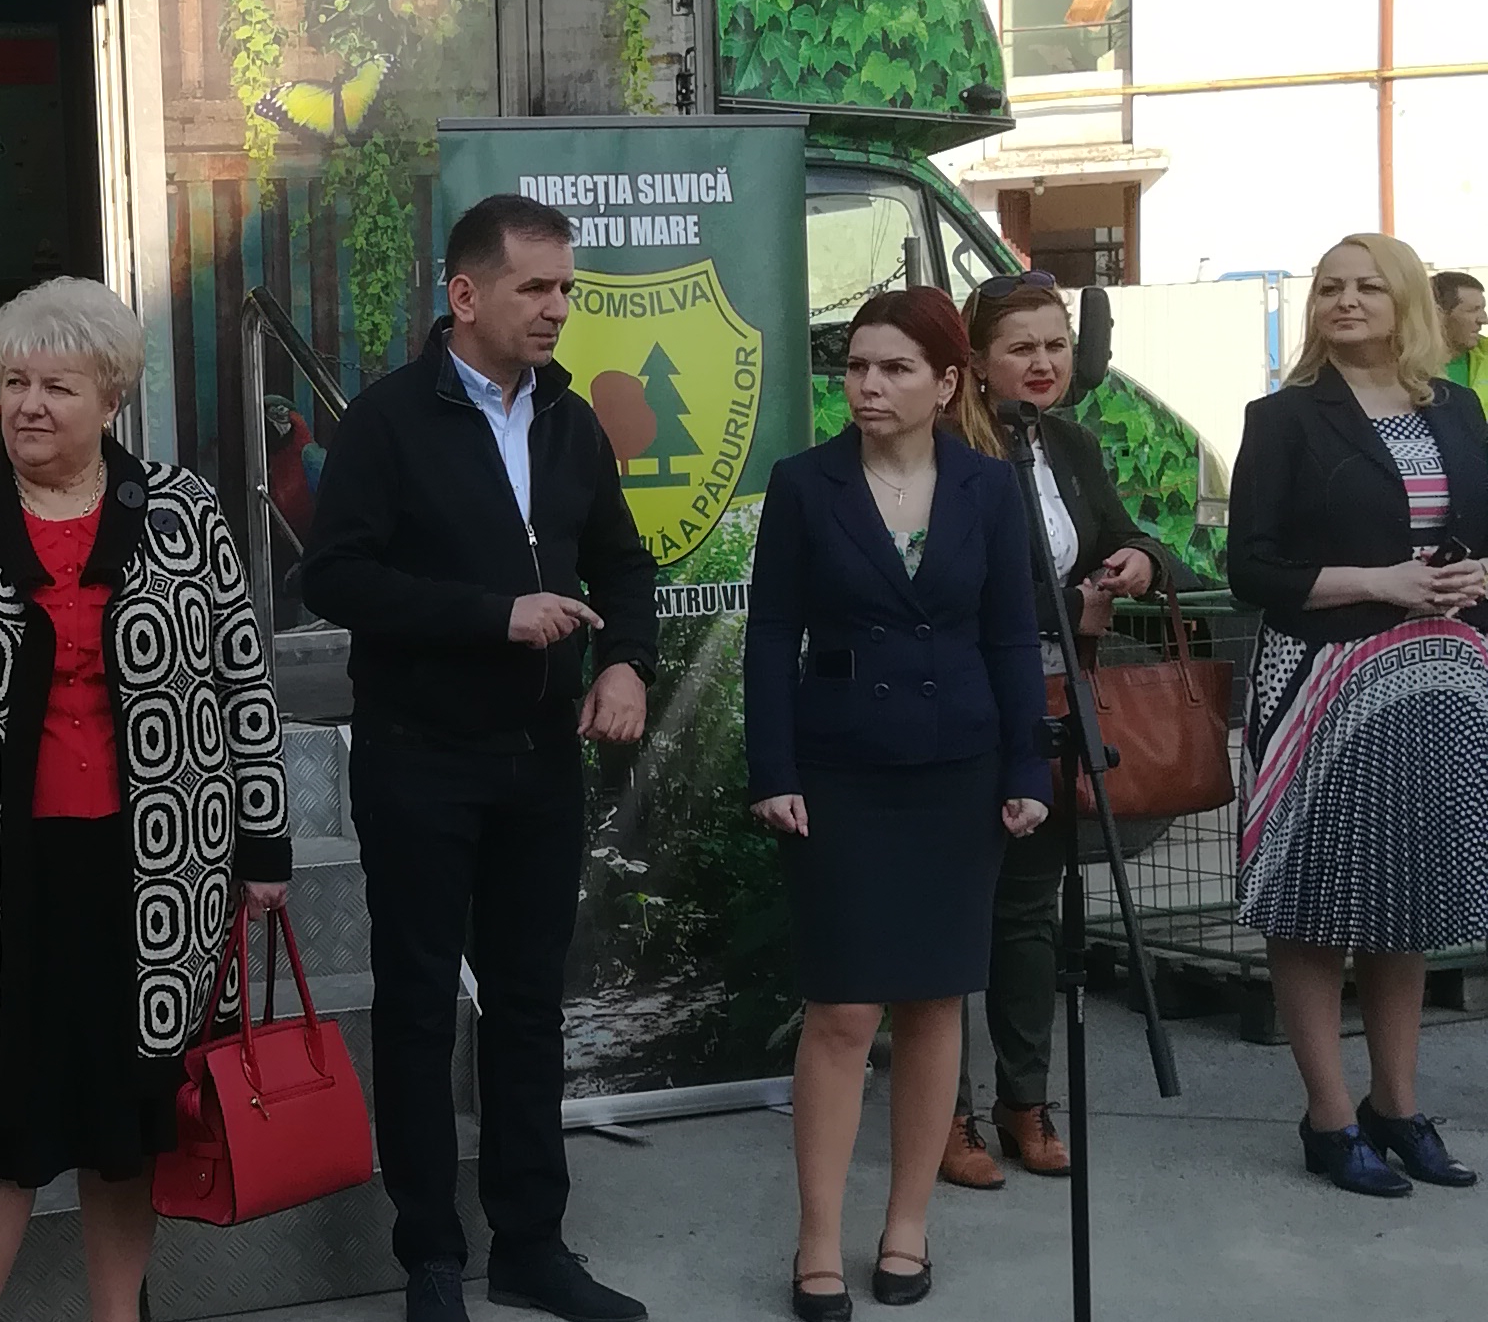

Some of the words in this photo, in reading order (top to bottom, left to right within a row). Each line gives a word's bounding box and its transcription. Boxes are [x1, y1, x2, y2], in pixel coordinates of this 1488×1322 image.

[519, 174, 634, 214] DIRECȚIA
[637, 166, 733, 204] SILVICĂ
[569, 216, 626, 247] SATU
[630, 215, 701, 246] MARE
[568, 279, 712, 319] ROMSILVA
[679, 518, 702, 544] A
[692, 346, 758, 519] PĂDURILOR
[655, 584, 718, 616] NTRU
[720, 583, 750, 612] VI
